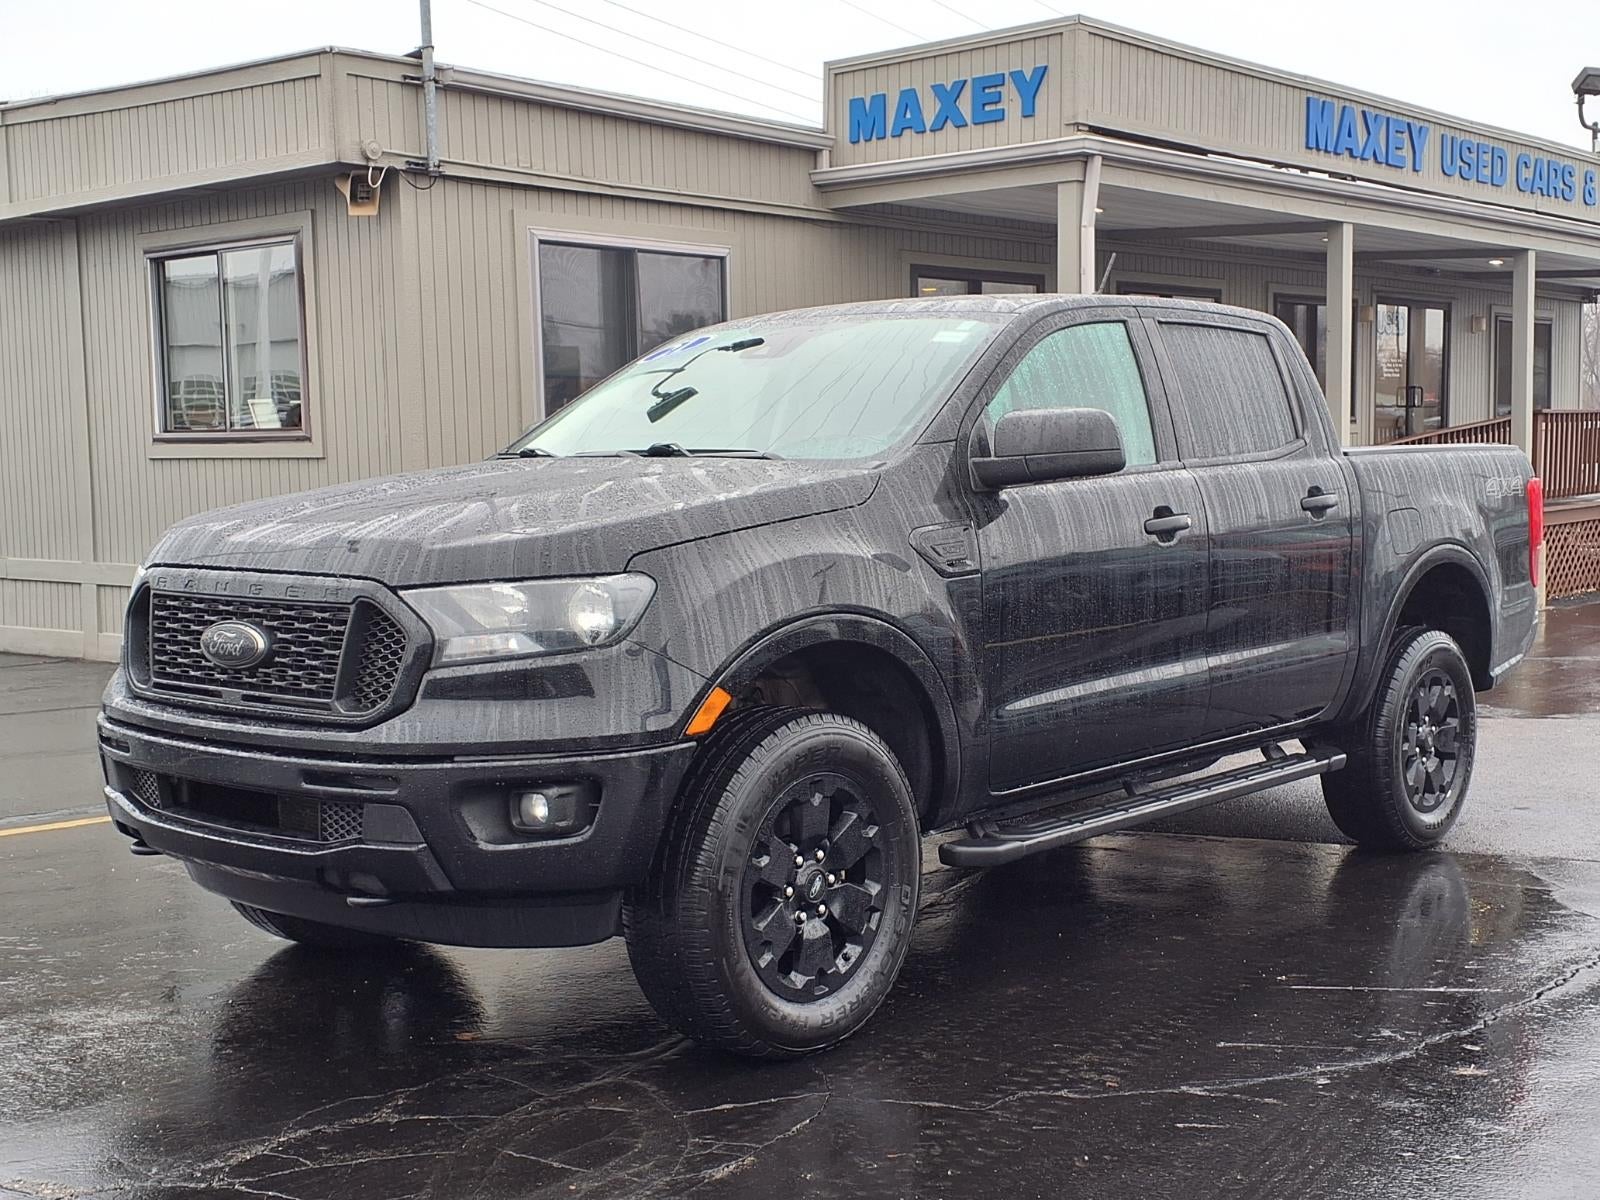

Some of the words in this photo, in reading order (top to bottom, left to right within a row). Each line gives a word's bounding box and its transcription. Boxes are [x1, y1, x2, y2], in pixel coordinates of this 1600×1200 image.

[848, 65, 1048, 144] MAXEY
[1306, 96, 1429, 172] MAXEY
[1441, 133, 1508, 187] USED
[1516, 152, 1575, 201] CARS
[1583, 169, 1596, 206] &
[154, 575, 342, 597] RANGER
[208, 630, 244, 657] Ford
